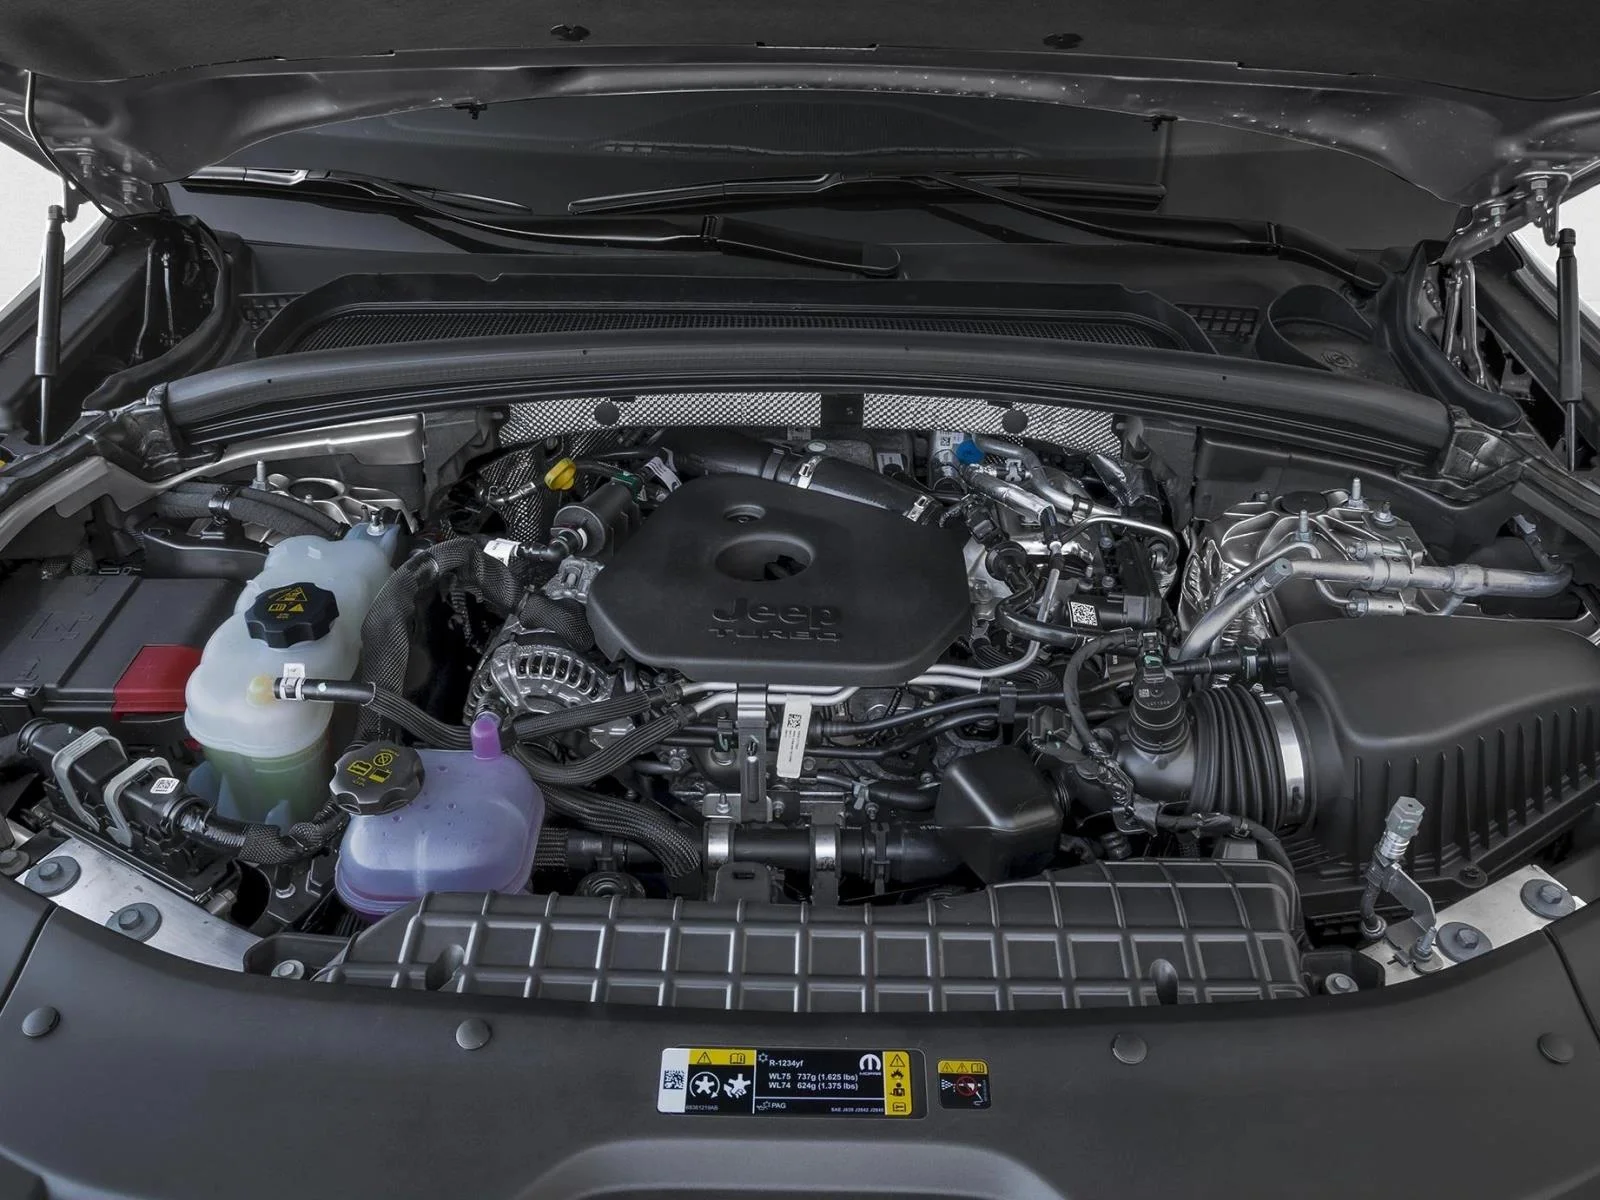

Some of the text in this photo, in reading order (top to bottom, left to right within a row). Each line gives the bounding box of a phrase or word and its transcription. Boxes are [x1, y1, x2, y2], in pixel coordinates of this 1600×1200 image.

[711, 597, 843, 631] Jeep
[708, 628, 841, 643] TURBO
[769, 1060, 804, 1068] R-1234yf
[797, 1073, 817, 1082] 737g
[818, 1073, 842, 1082] (1.625
[843, 1073, 859, 1082] lbs)
[768, 1081, 859, 1091] WL74 624g (1.375 lbs)
